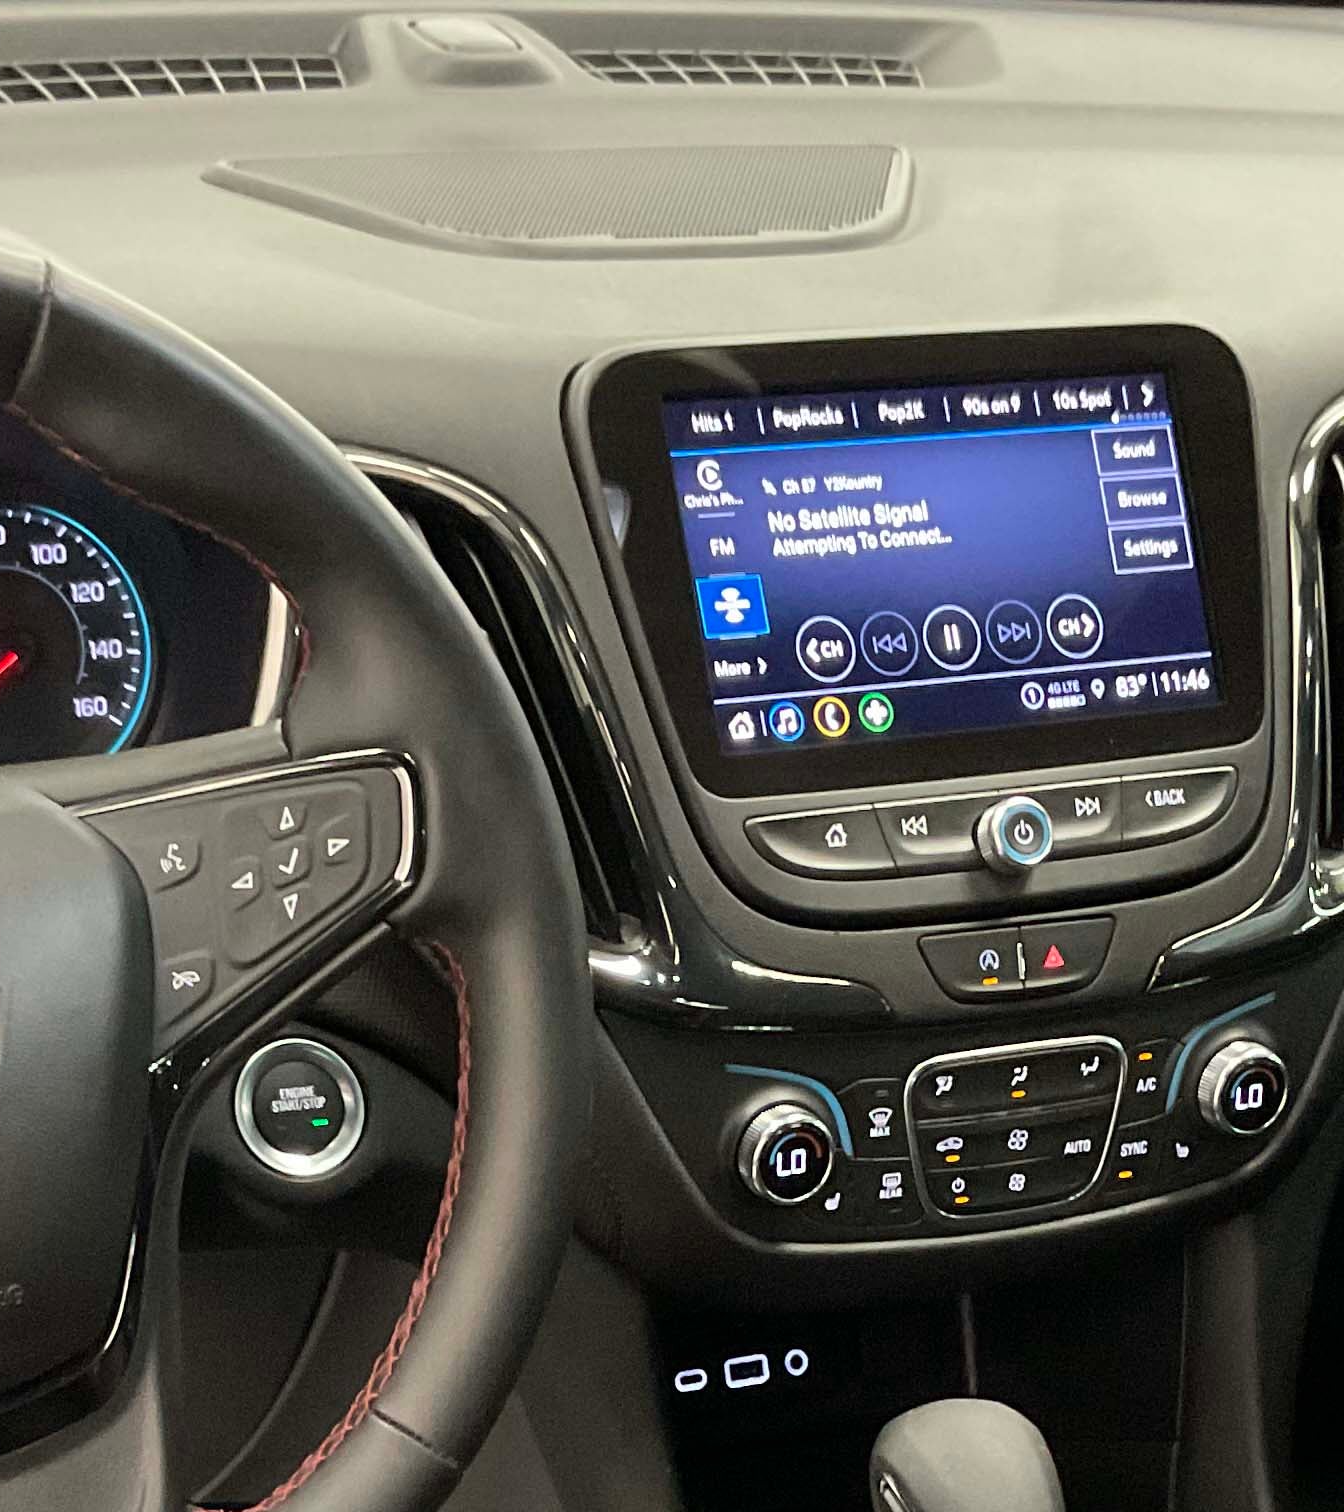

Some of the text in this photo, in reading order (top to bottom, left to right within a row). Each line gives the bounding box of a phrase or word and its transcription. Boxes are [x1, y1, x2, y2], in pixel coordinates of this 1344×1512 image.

[962, 391, 1021, 417] 90s on 9
[1053, 386, 1112, 412] 10s Spot
[691, 407, 734, 434] Hits 1
[772, 405, 844, 431] PopRocks
[878, 398, 925, 424] Pop2K
[1112, 437, 1155, 459] Sound
[782, 477, 800, 496] Ch
[1118, 489, 1168, 509] Browse
[767, 499, 929, 533] No Satellite Signal
[709, 536, 735, 557] FM
[773, 525, 952, 557] Attempting To Connect...
[1123, 538, 1179, 559] Settings
[29, 542, 68, 566] 100
[69, 580, 106, 603] 120
[1058, 617, 1081, 637] CH
[87, 638, 124, 661] 140
[820, 639, 844, 658] CH
[714, 659, 751, 678] More
[1160, 667, 1210, 693] 11:46
[72, 695, 108, 718] 160
[1153, 788, 1186, 807] BACK
[279, 1085, 315, 1099] ENGINE
[1136, 1077, 1157, 1093] A/C
[1234, 1083, 1264, 1111] LO
[1064, 1139, 1092, 1156] AUTO
[1120, 1140, 1149, 1158] SYNC
[776, 1148, 807, 1178] LO
